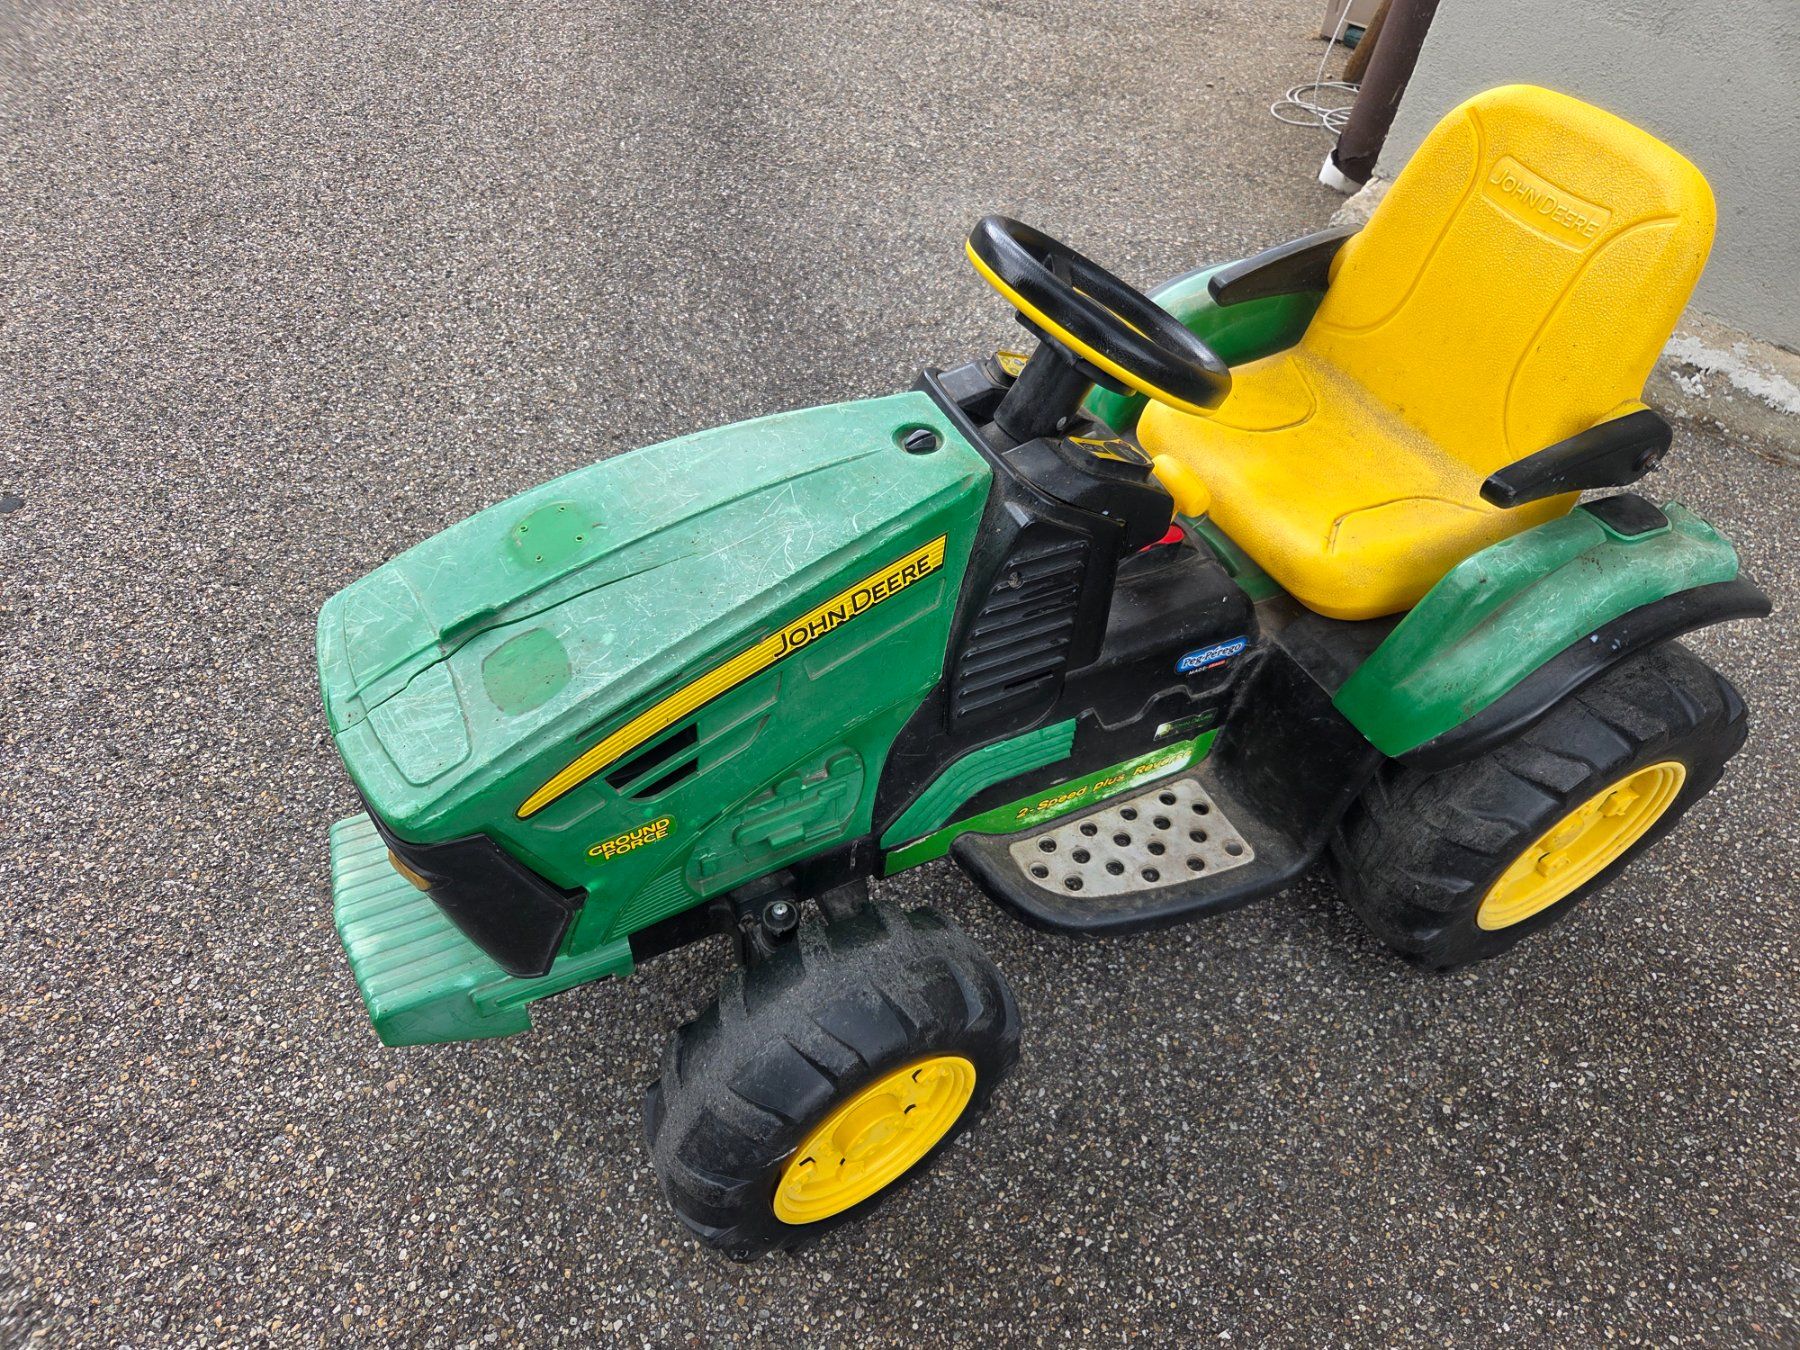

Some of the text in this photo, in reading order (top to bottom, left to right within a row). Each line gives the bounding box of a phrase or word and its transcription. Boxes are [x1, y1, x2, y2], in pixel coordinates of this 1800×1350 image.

[1490, 169, 1601, 238] JOHN DEERE
[773, 554, 932, 658] JOHN DEERE
[1092, 774, 1125, 792] plus
[588, 818, 670, 856] GROUND
[604, 827, 669, 860] FORCE
